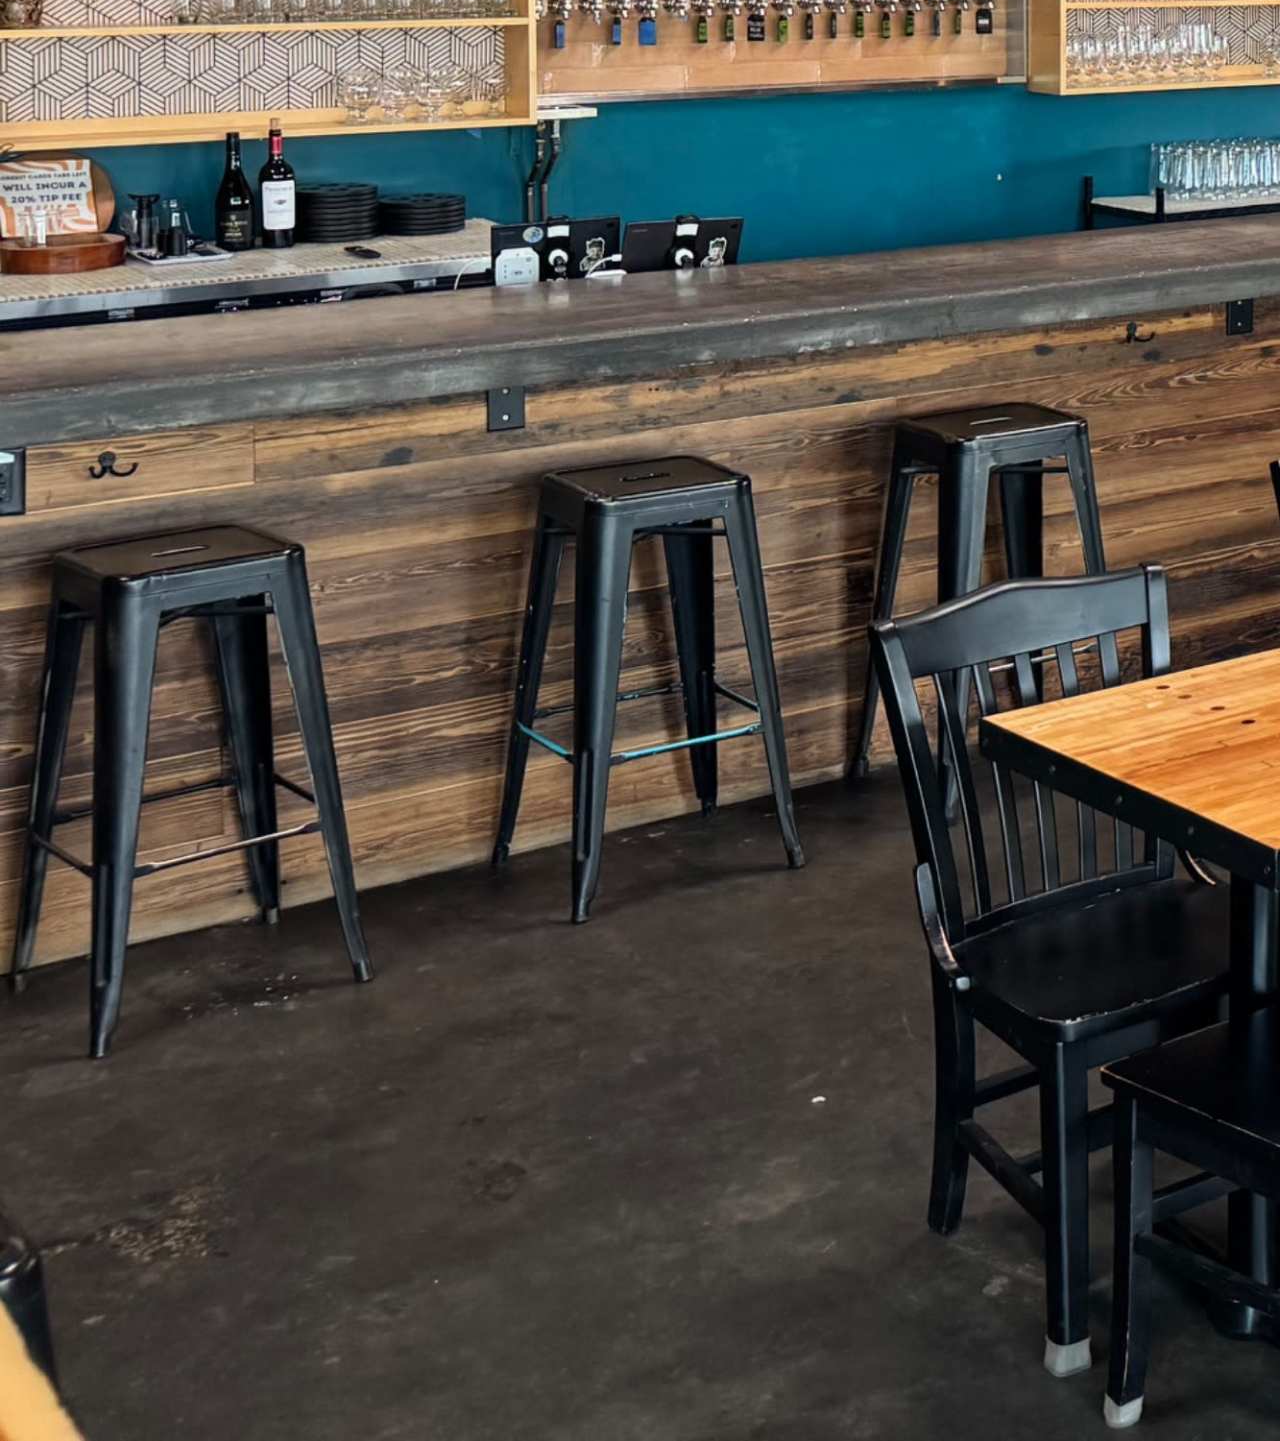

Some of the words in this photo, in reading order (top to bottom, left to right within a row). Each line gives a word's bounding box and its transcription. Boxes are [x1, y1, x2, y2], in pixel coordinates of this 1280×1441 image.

[2, 183, 33, 192] WILL
[36, 181, 75, 190] INCUR
[40, 194, 59, 202] TIP
[62, 193, 82, 201] FEE
